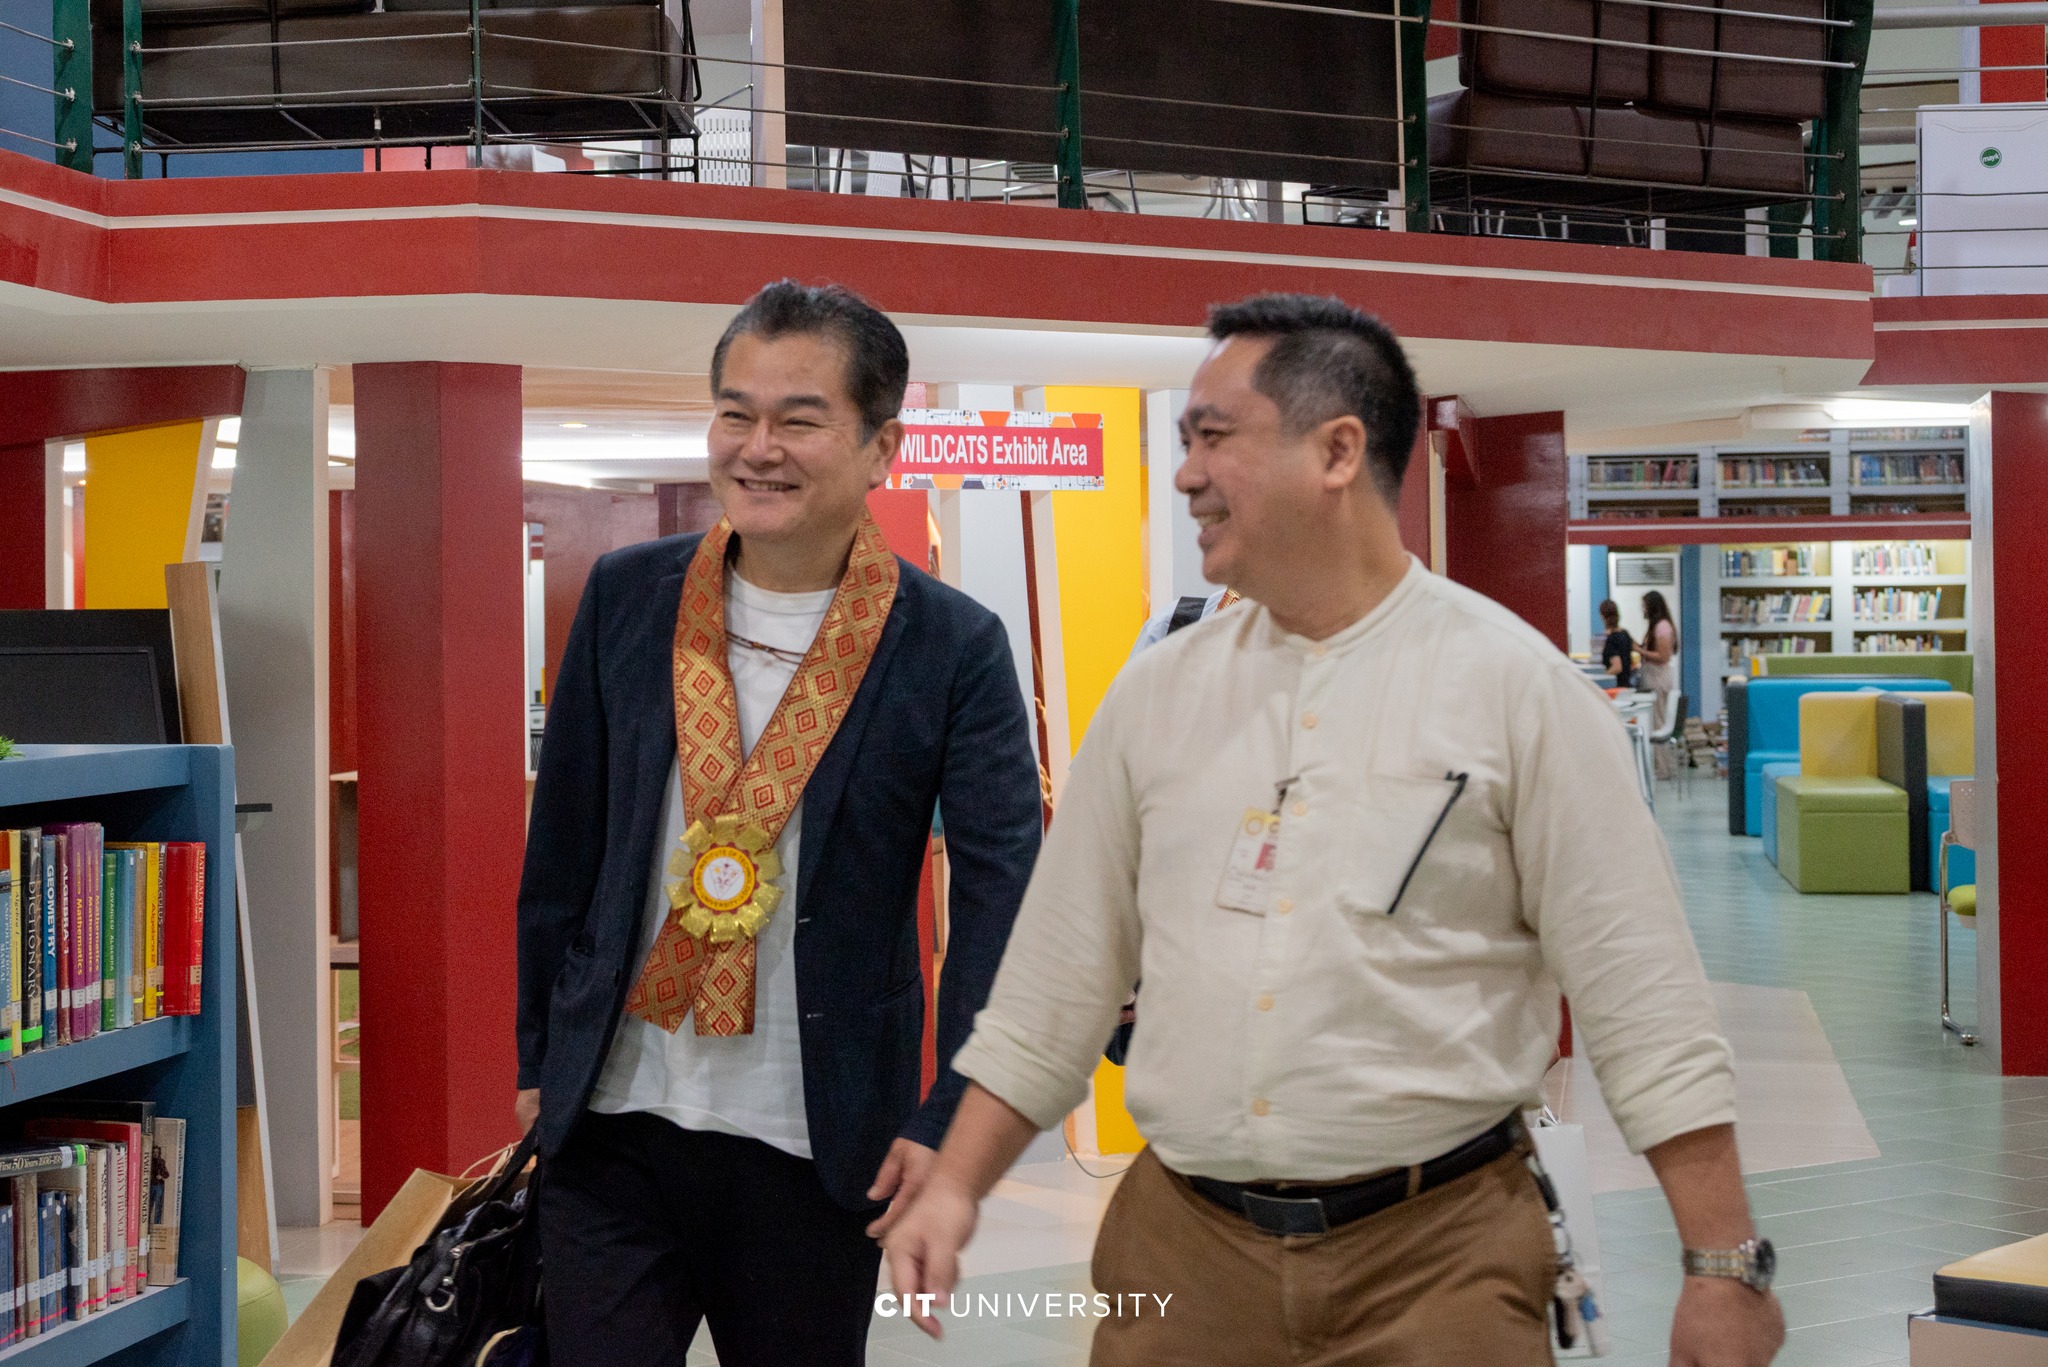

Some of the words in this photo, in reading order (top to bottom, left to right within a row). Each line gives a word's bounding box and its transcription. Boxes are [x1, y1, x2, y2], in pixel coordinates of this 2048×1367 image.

[900, 434, 988, 464] WILDCATS
[993, 436, 1048, 465] Exhibit
[1051, 437, 1088, 466] Area
[47, 864, 56, 958] GEOMETRY
[28, 881, 37, 1001] DICTIONARY
[12, 1157, 24, 1171] 50
[142, 1177, 148, 1189] OF
